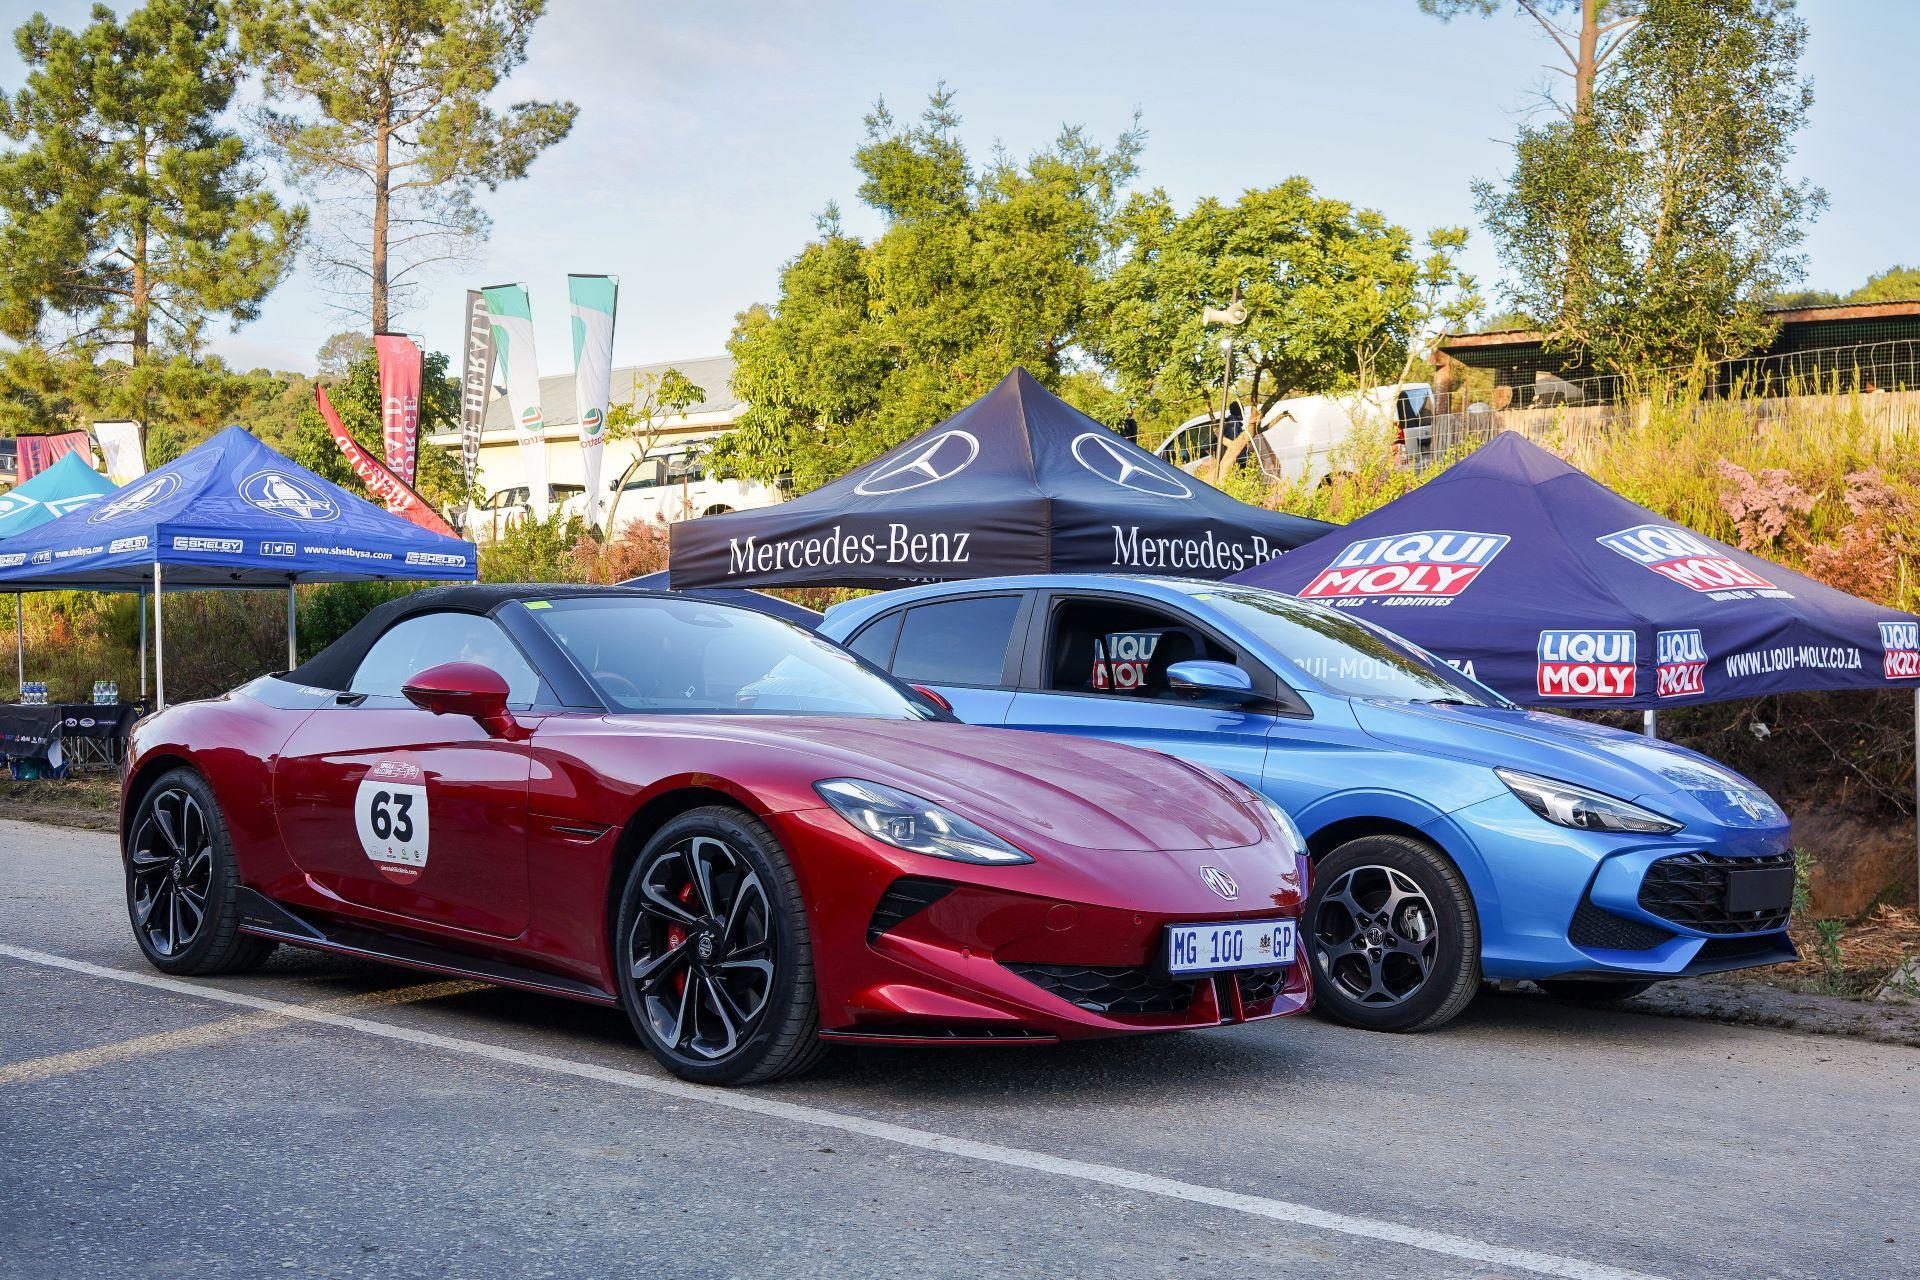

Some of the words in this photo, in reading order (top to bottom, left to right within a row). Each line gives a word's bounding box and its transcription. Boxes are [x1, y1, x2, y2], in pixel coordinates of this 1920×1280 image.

[189, 540, 240, 550] SHELBY
[304, 546, 393, 560] www.shelbysa.com
[419, 555, 463, 564] SHELBY
[728, 523, 971, 575] Mercedes-Benz
[1112, 525, 1291, 571] Mercedes-B
[1336, 534, 1499, 568] LIQUI
[1607, 528, 1719, 563] LIQUI
[1308, 565, 1479, 595] MOLY
[1656, 558, 1763, 589] MOLY
[1335, 598, 1367, 607] OILS
[1382, 597, 1455, 606] ADDITIVES
[1099, 636, 1159, 661] LIQU
[1543, 634, 1630, 663] LIQUI
[1659, 633, 1704, 663] LIQUI
[1881, 624, 1918, 650] LIQUI
[1097, 663, 1149, 687] MOL
[1726, 646, 1862, 678] WWW.LIQUI-MOLY.CO.ZA
[1543, 665, 1634, 693] MOLY
[1659, 664, 1704, 694] MOLY
[371, 790, 414, 843] 63
[1202, 867, 1237, 898] MG
[1174, 931, 1197, 965] MG
[1210, 930, 1243, 963] 100
[1273, 926, 1292, 958] GP
